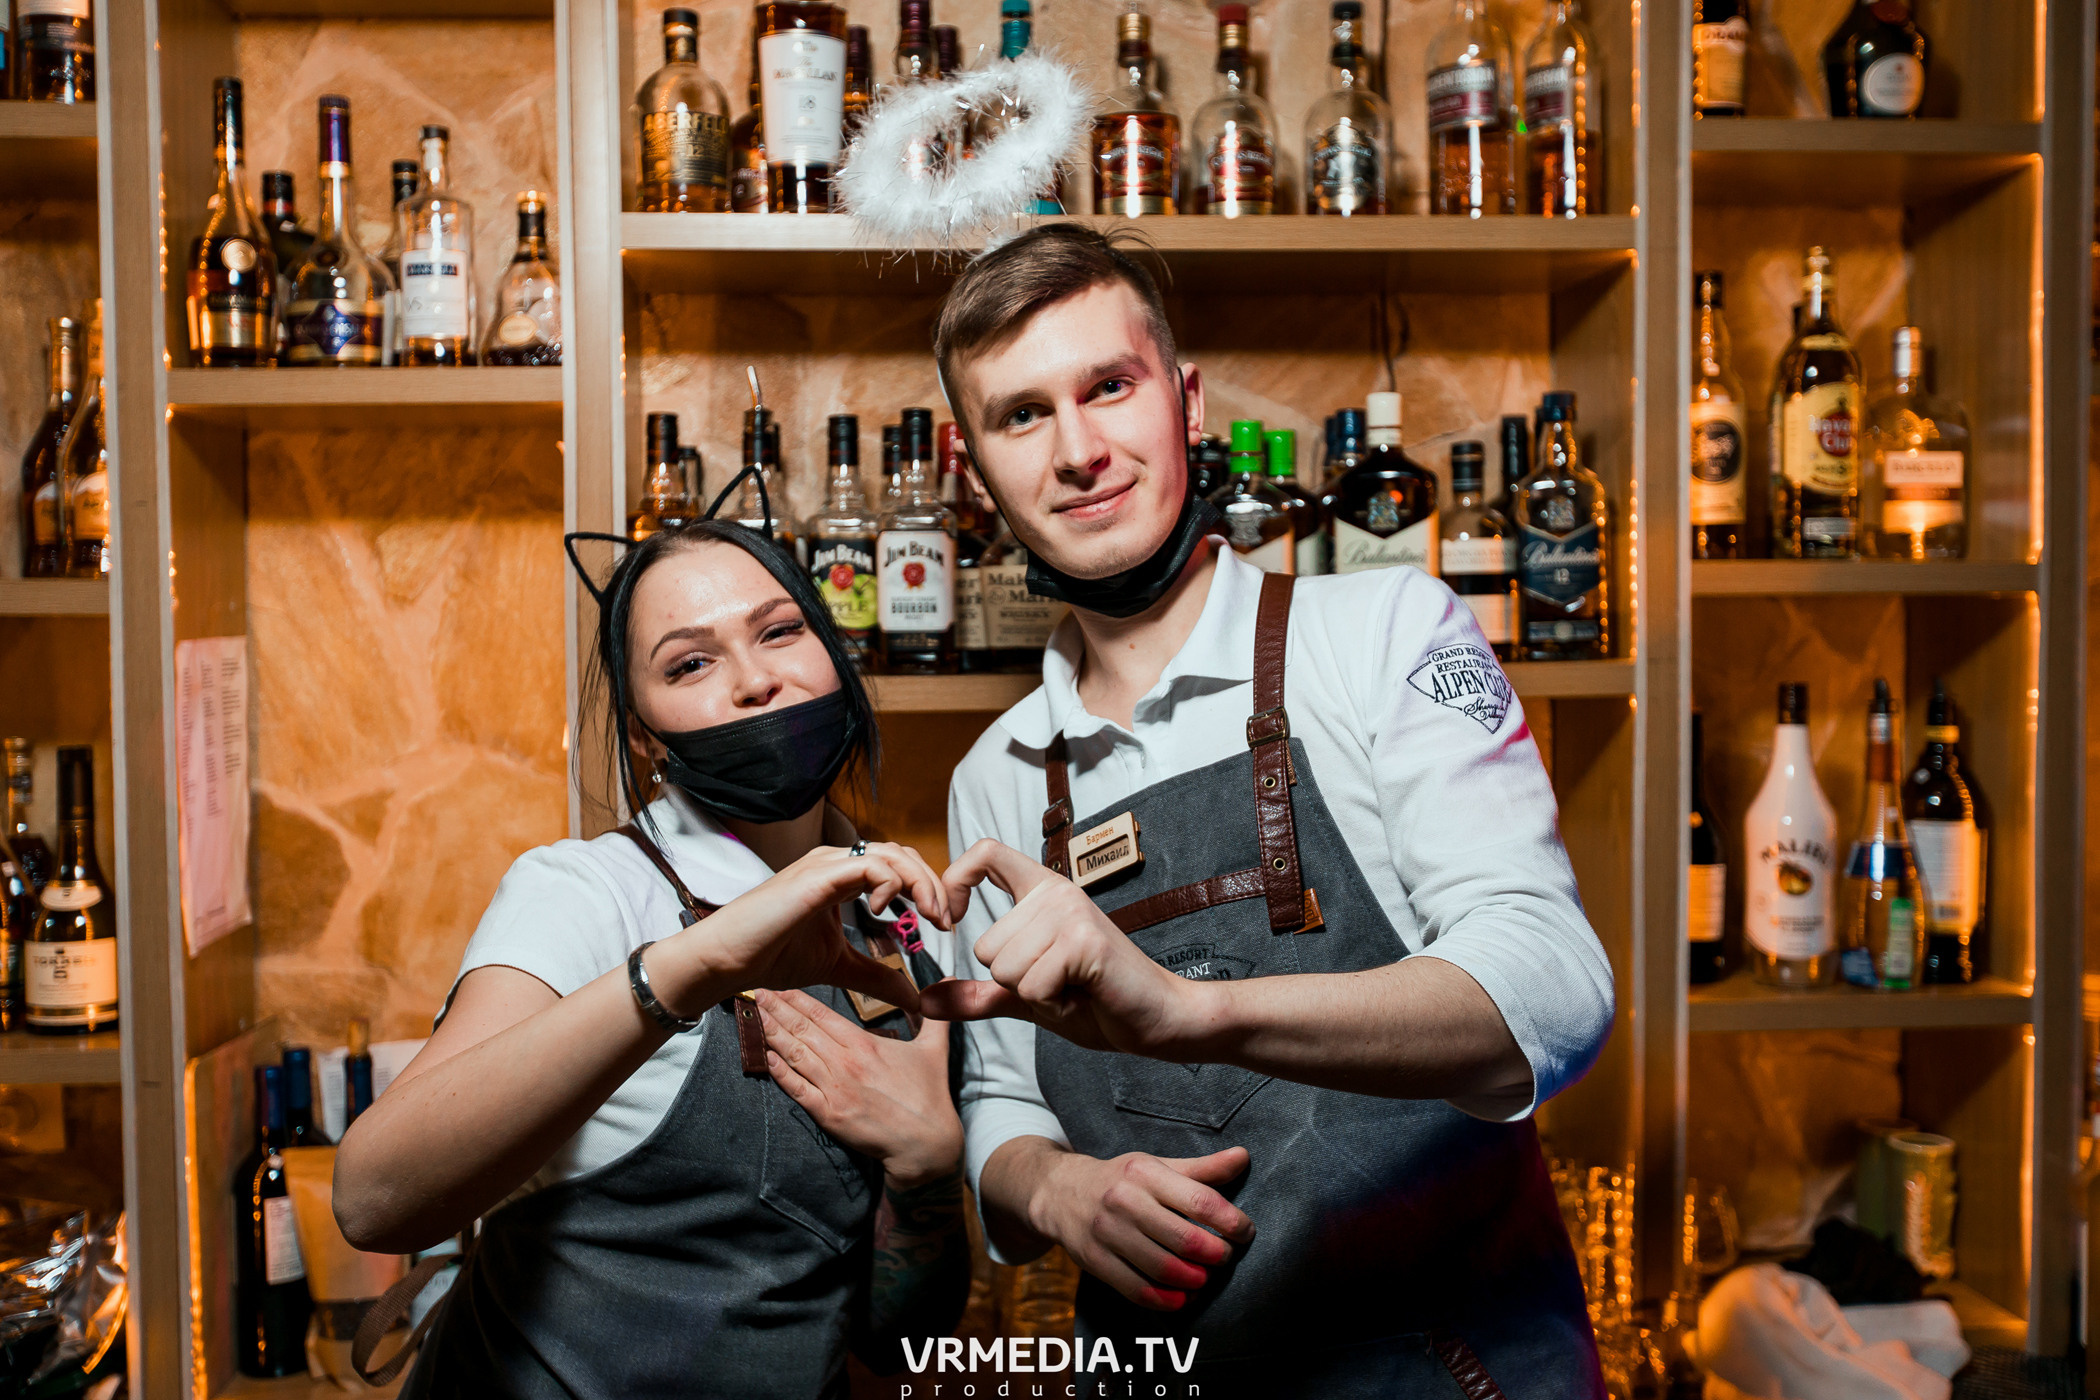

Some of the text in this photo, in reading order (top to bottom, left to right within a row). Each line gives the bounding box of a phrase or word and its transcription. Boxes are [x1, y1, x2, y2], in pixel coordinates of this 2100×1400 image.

[811, 544, 873, 574] JIM BEAM
[885, 541, 945, 568] JIM BEAM
[1432, 647, 1464, 663] GRAND
[1431, 669, 1486, 703] ALPEN
[1086, 826, 1115, 846] Бармен
[1086, 844, 1129, 871] Михаил
[1167, 948, 1210, 967] RESORT
